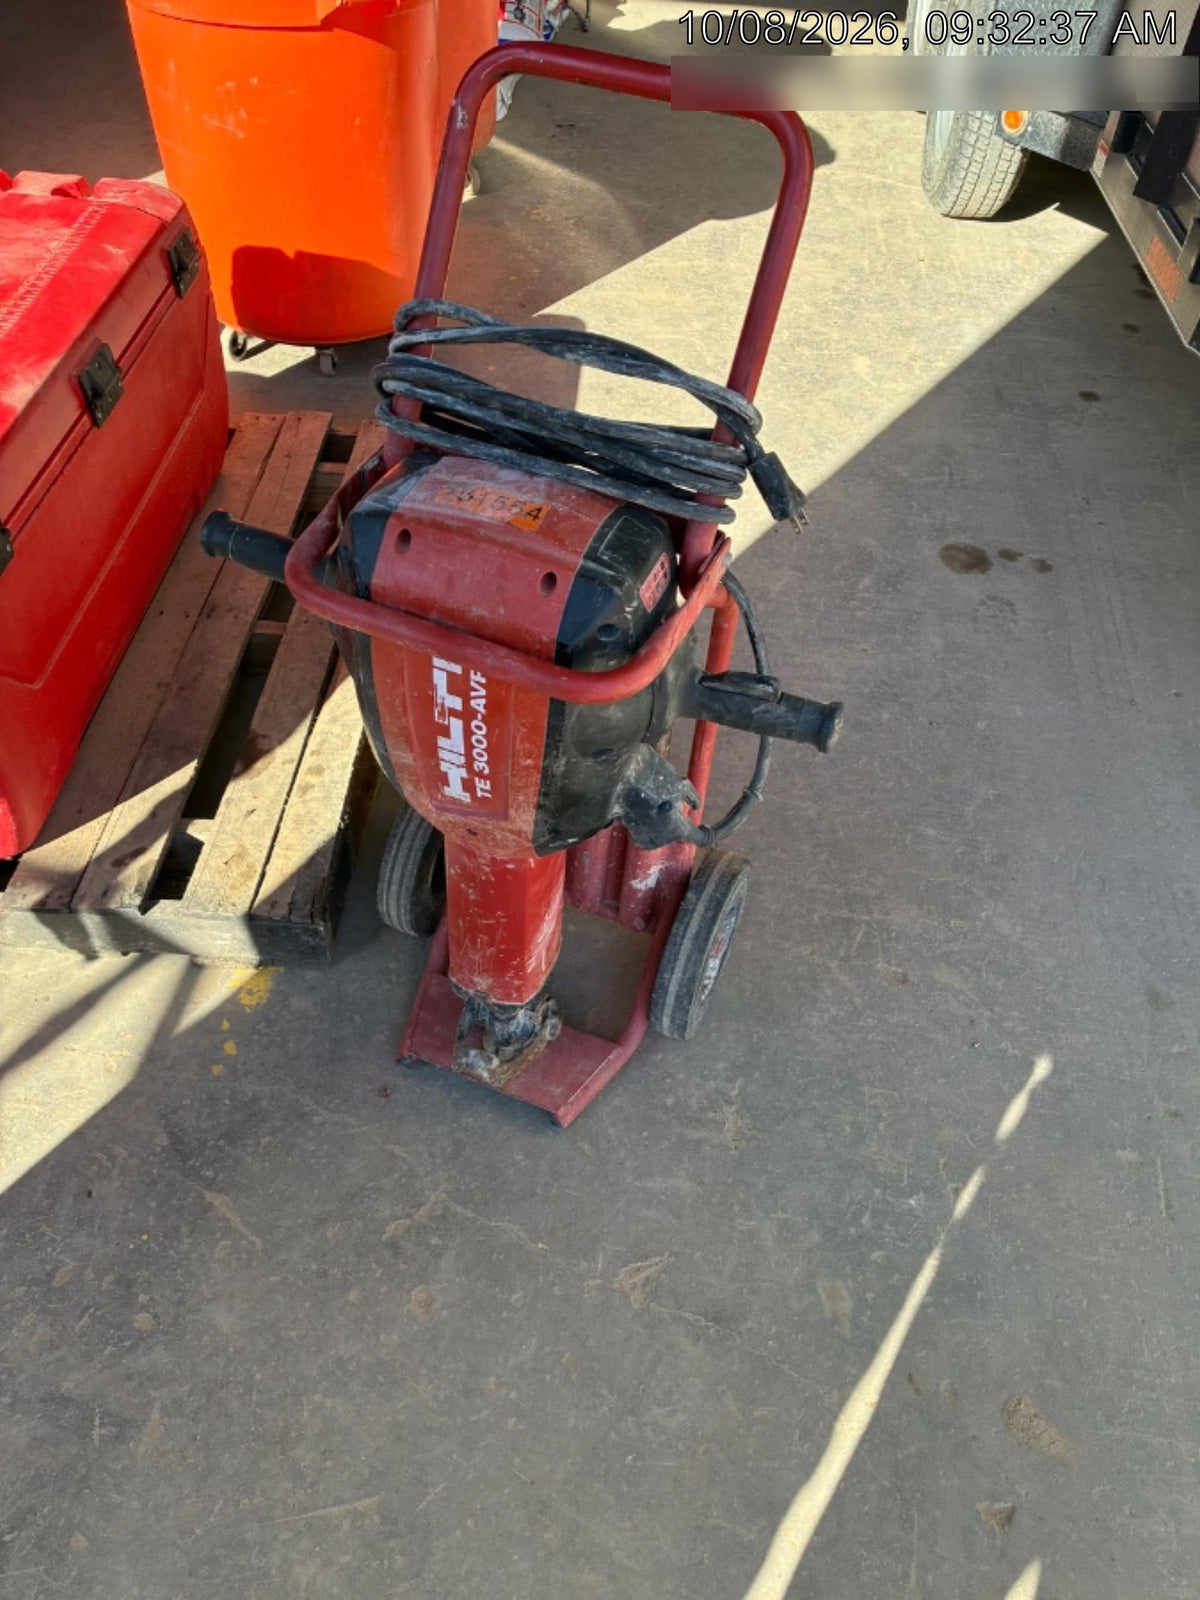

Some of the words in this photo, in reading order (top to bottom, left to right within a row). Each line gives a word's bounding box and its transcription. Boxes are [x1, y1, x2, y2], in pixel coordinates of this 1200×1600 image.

[432, 656, 471, 803] HILTI
[470, 669, 490, 775] 3000-AVF
[474, 776, 492, 798] TE
